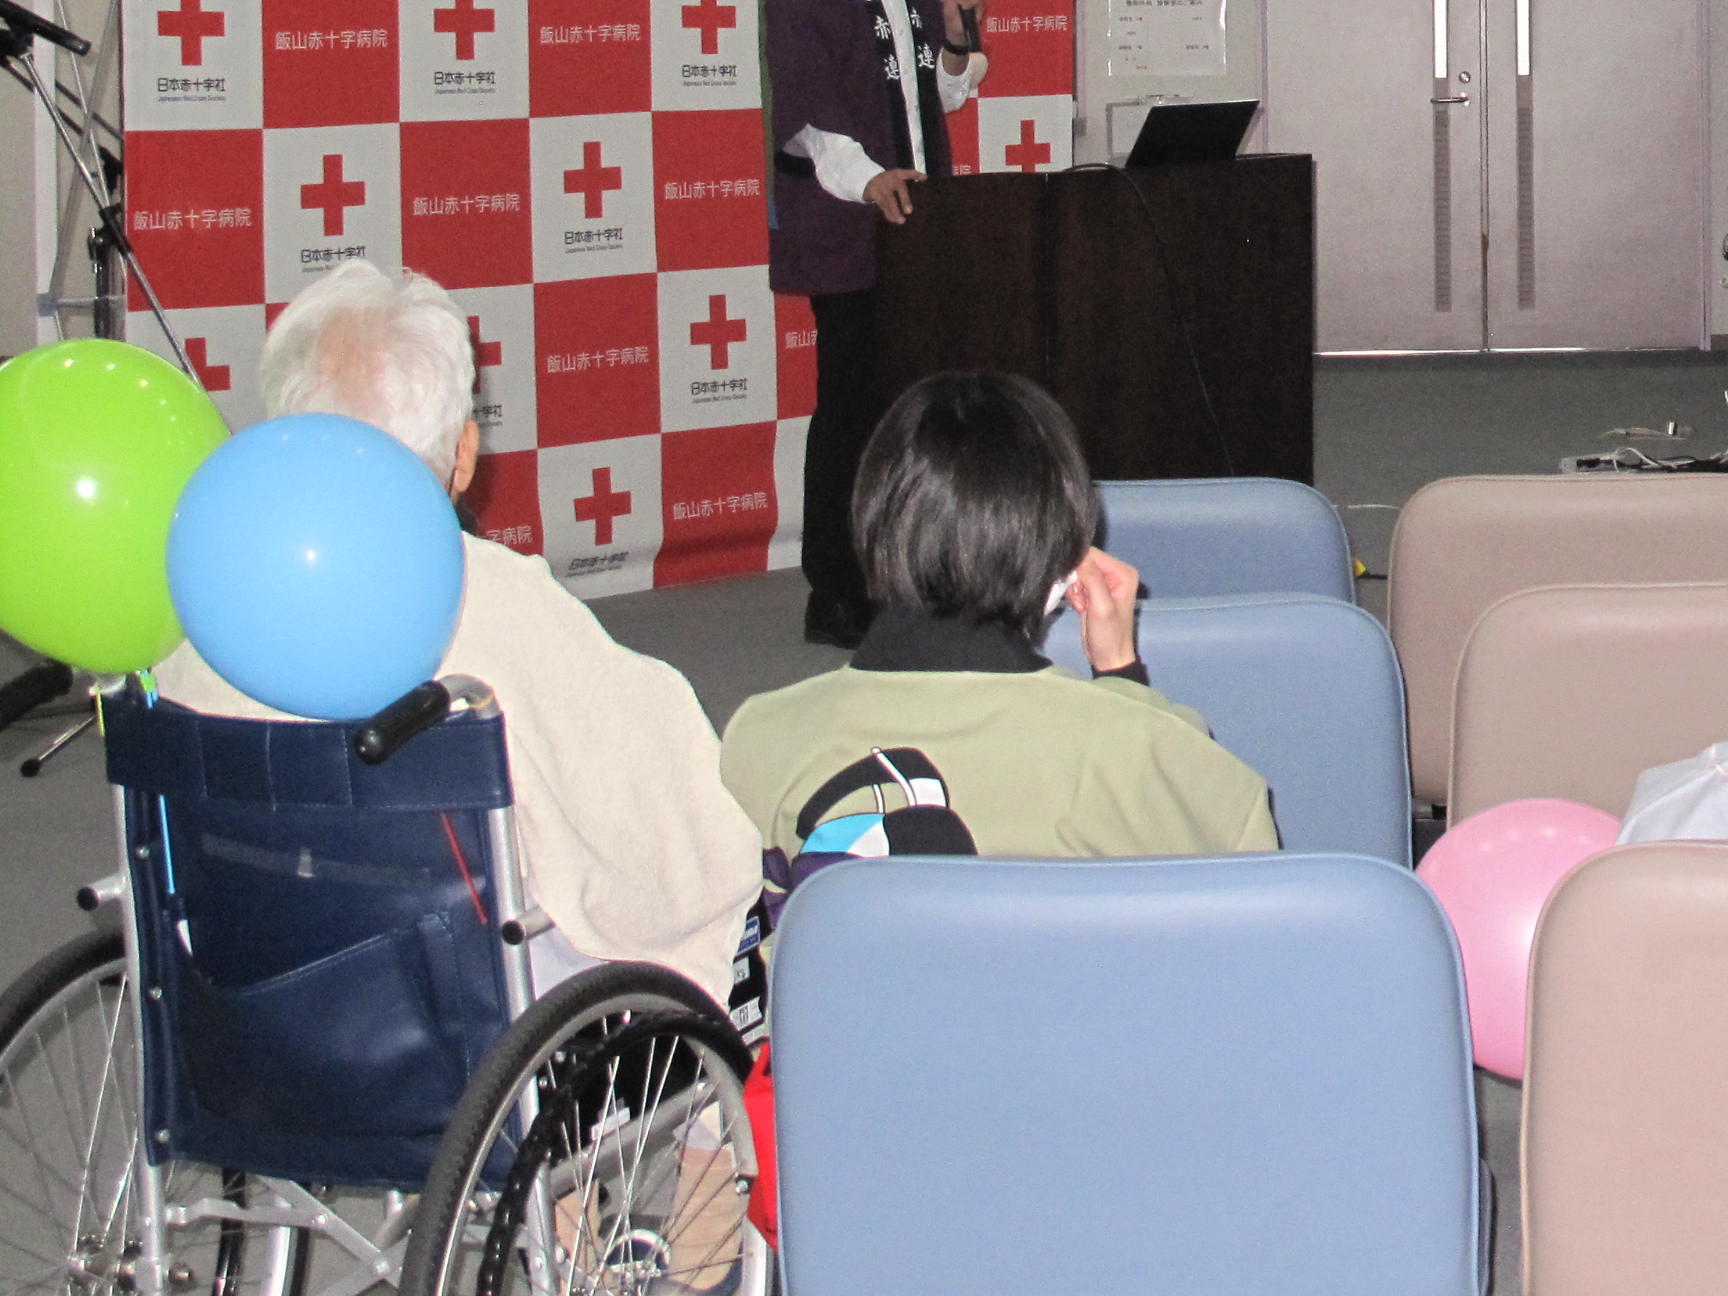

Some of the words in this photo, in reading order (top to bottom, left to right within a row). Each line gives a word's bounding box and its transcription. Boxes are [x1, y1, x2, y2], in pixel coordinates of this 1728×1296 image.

[540, 24, 640, 43] 飯山赤十字病院
[987, 16, 1067, 32] 飯山赤十字病院
[276, 29, 387, 49] 飯山赤十字病院
[434, 72, 495, 85] 日本赤十字社
[682, 65, 736, 77] 日本赤十字社
[158, 78, 225, 92] 日本赤十字社
[665, 179, 760, 200] 飯山赤十字病院
[413, 194, 520, 215] 飯山赤十字病院
[135, 208, 251, 229] 飯山赤十字病院
[565, 228, 622, 245] 日本赤十字社
[547, 346, 648, 373] 飯山赤十字病院
[691, 378, 747, 395] 日本赤十字社
[673, 492, 767, 520] 飯山赤十字病院
